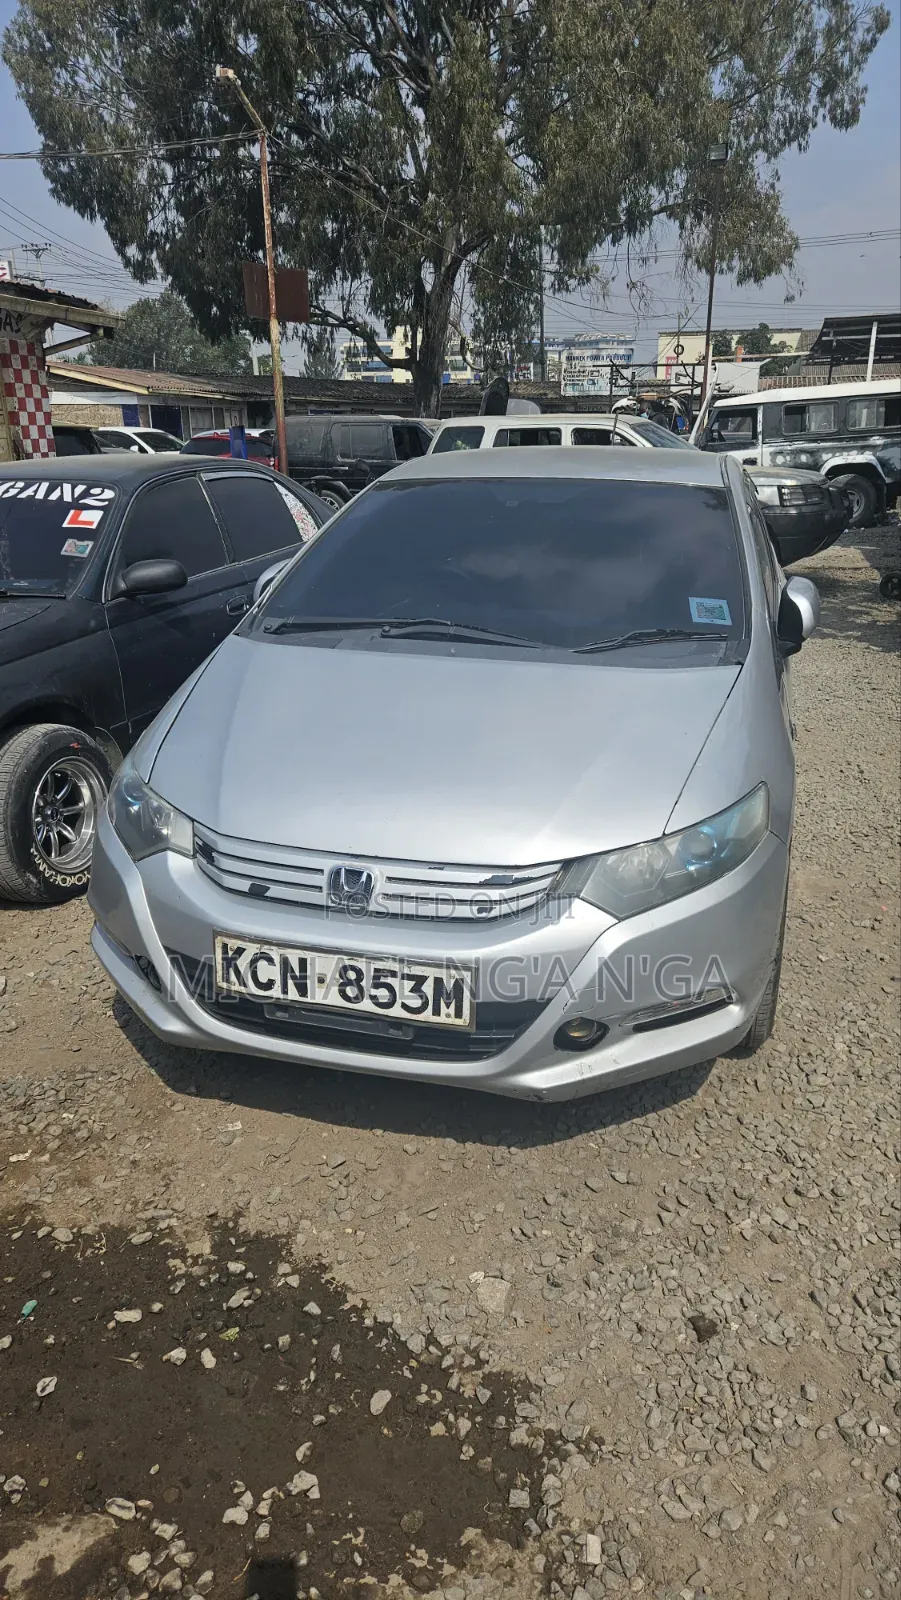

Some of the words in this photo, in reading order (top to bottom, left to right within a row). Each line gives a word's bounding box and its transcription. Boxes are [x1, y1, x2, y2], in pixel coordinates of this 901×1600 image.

[0, 480, 115, 507] GAN2
[67, 509, 95, 527] L
[30, 843, 91, 887] YOKOHAMA
[222, 943, 308, 998] KCN
[337, 964, 464, 1019] 853M
